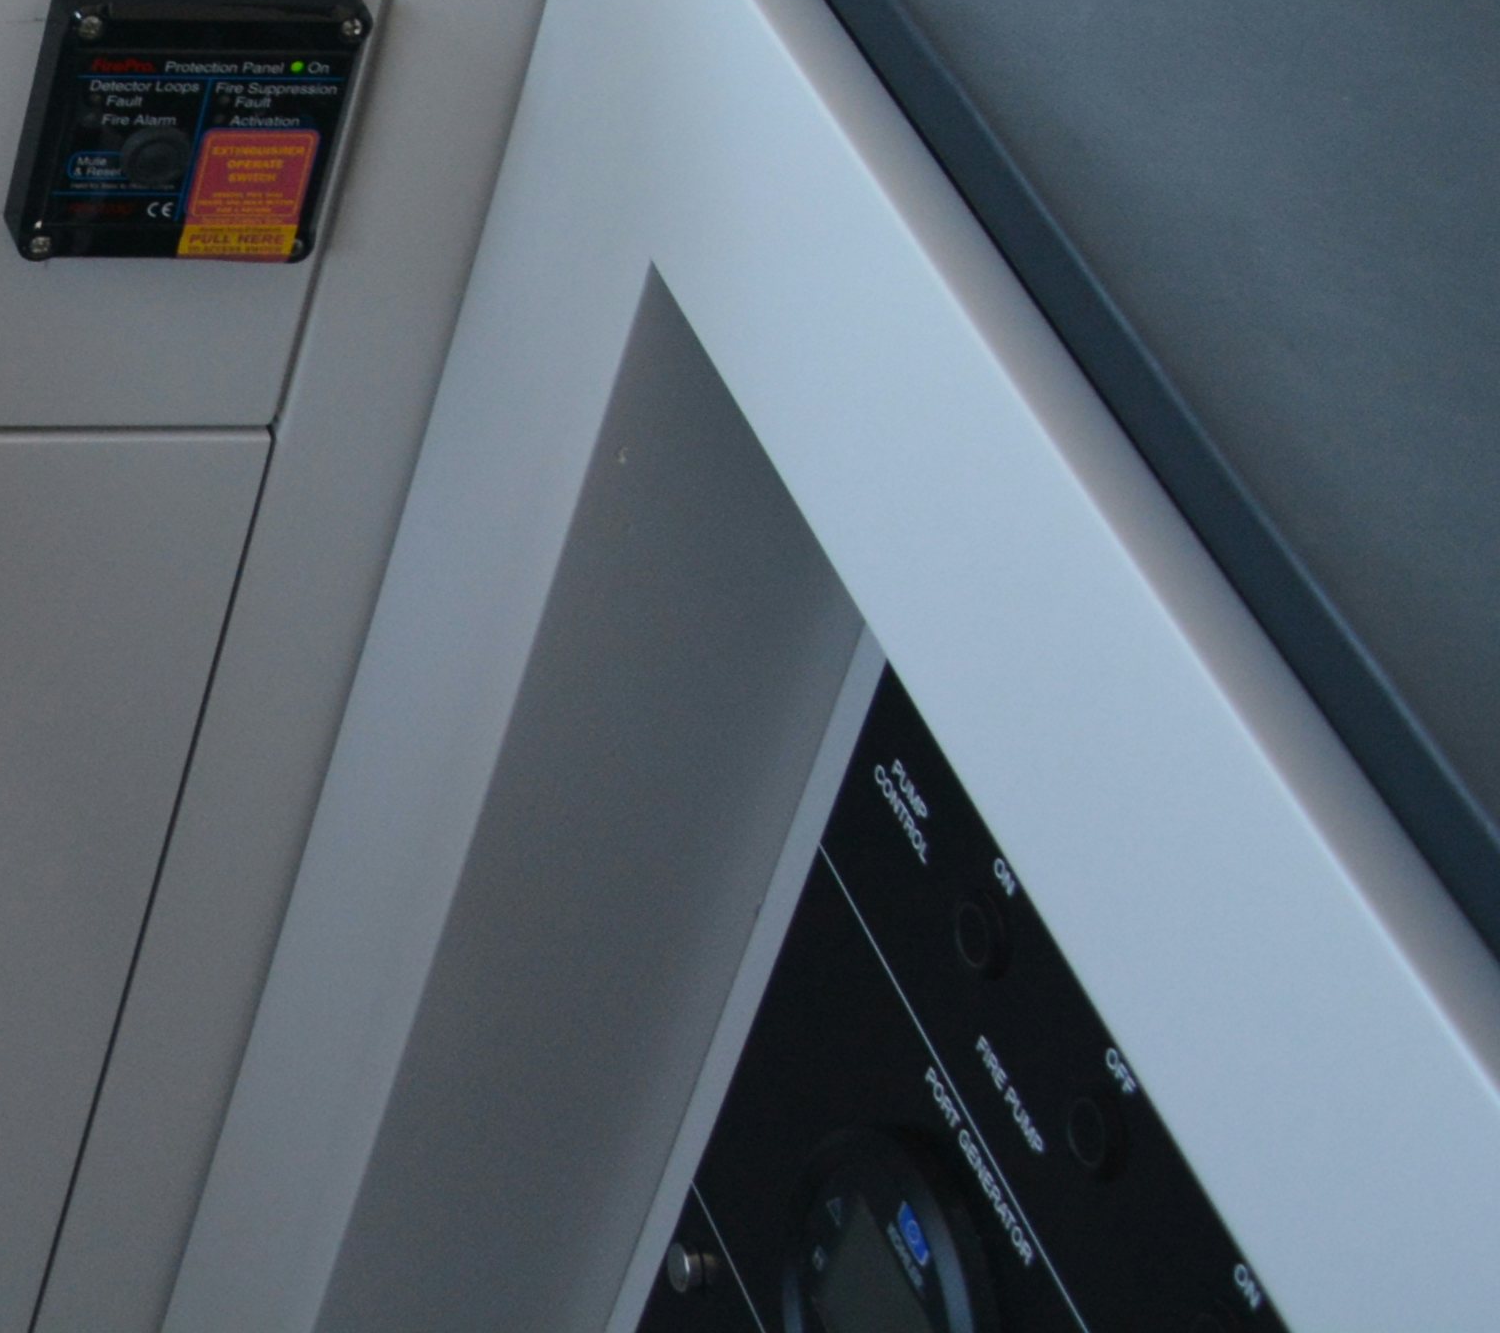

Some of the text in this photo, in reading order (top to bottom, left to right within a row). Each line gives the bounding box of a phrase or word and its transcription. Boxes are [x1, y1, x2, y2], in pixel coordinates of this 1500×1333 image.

[165, 60, 238, 73] Protection
[242, 61, 285, 74] Panel
[307, 61, 330, 74] On
[90, 79, 200, 94] Detector Loops
[216, 82, 338, 96] Fire Suppression
[106, 94, 143, 107] Fault
[235, 96, 272, 108] Fault
[101, 113, 177, 125] Fire Alarm
[230, 115, 300, 126] Activation
[891, 758, 928, 818] PUMP
[874, 764, 928, 866] CONTROL
[994, 858, 1017, 897] ON
[1106, 1047, 1137, 1094] OFF
[975, 1035, 1045, 1155] FIRE PUMP
[924, 1066, 1034, 1267] PORT GENERATOR
[1234, 1262, 1262, 1309] ON
